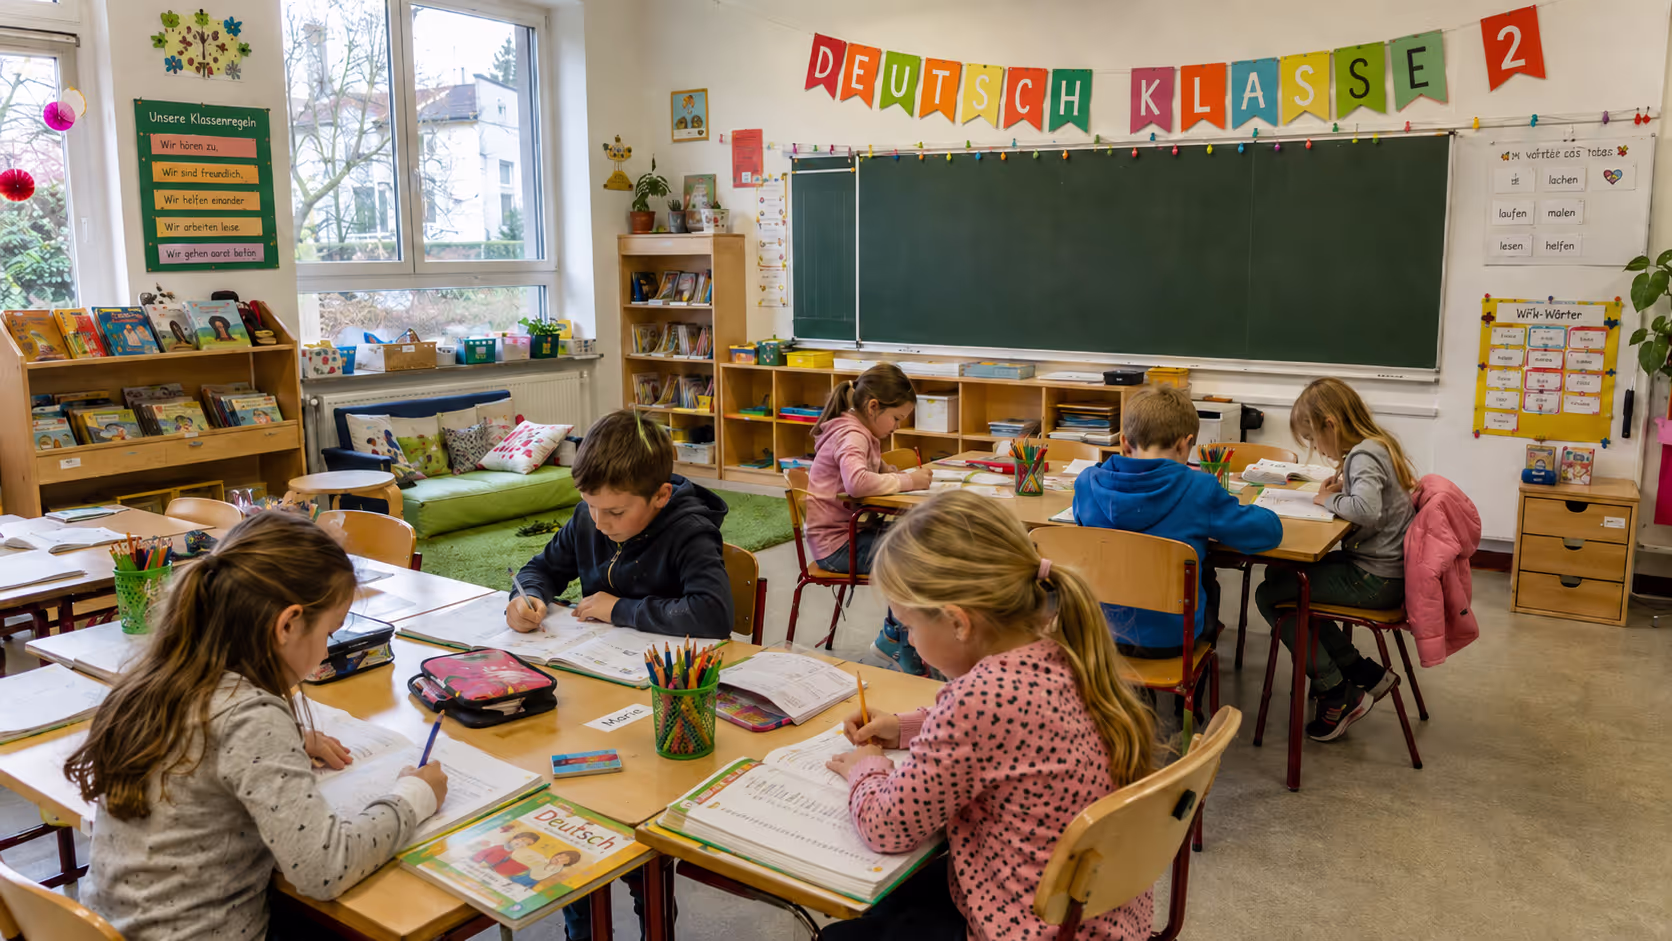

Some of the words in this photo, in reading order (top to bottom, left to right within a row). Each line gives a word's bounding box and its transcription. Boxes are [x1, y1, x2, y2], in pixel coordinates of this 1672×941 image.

[814, 45, 1081, 116] DEUTSCH
[1140, 46, 1429, 116] KLASSE
[1496, 25, 1526, 71] 2
[149, 112, 186, 124] Unsere
[191, 113, 257, 131] Klassenregeln
[160, 139, 177, 149] Wir
[179, 140, 203, 151] hören
[161, 168, 178, 177] Wir
[181, 168, 198, 178] sind
[1548, 174, 1579, 185] lachen
[163, 194, 179, 204] Wir
[182, 193, 208, 206] helfen
[211, 195, 245, 205] einander
[1498, 208, 1527, 221] laufen
[1547, 208, 1576, 217] malen
[164, 223, 180, 232] Wir
[184, 222, 218, 232] arbeiten
[1499, 241, 1523, 251] lesen
[1545, 240, 1575, 253] helfen
[166, 249, 181, 258] Wir
[184, 248, 208, 261] gehen
[601, 708, 645, 727] Marie
[534, 809, 618, 852] Deutsch
